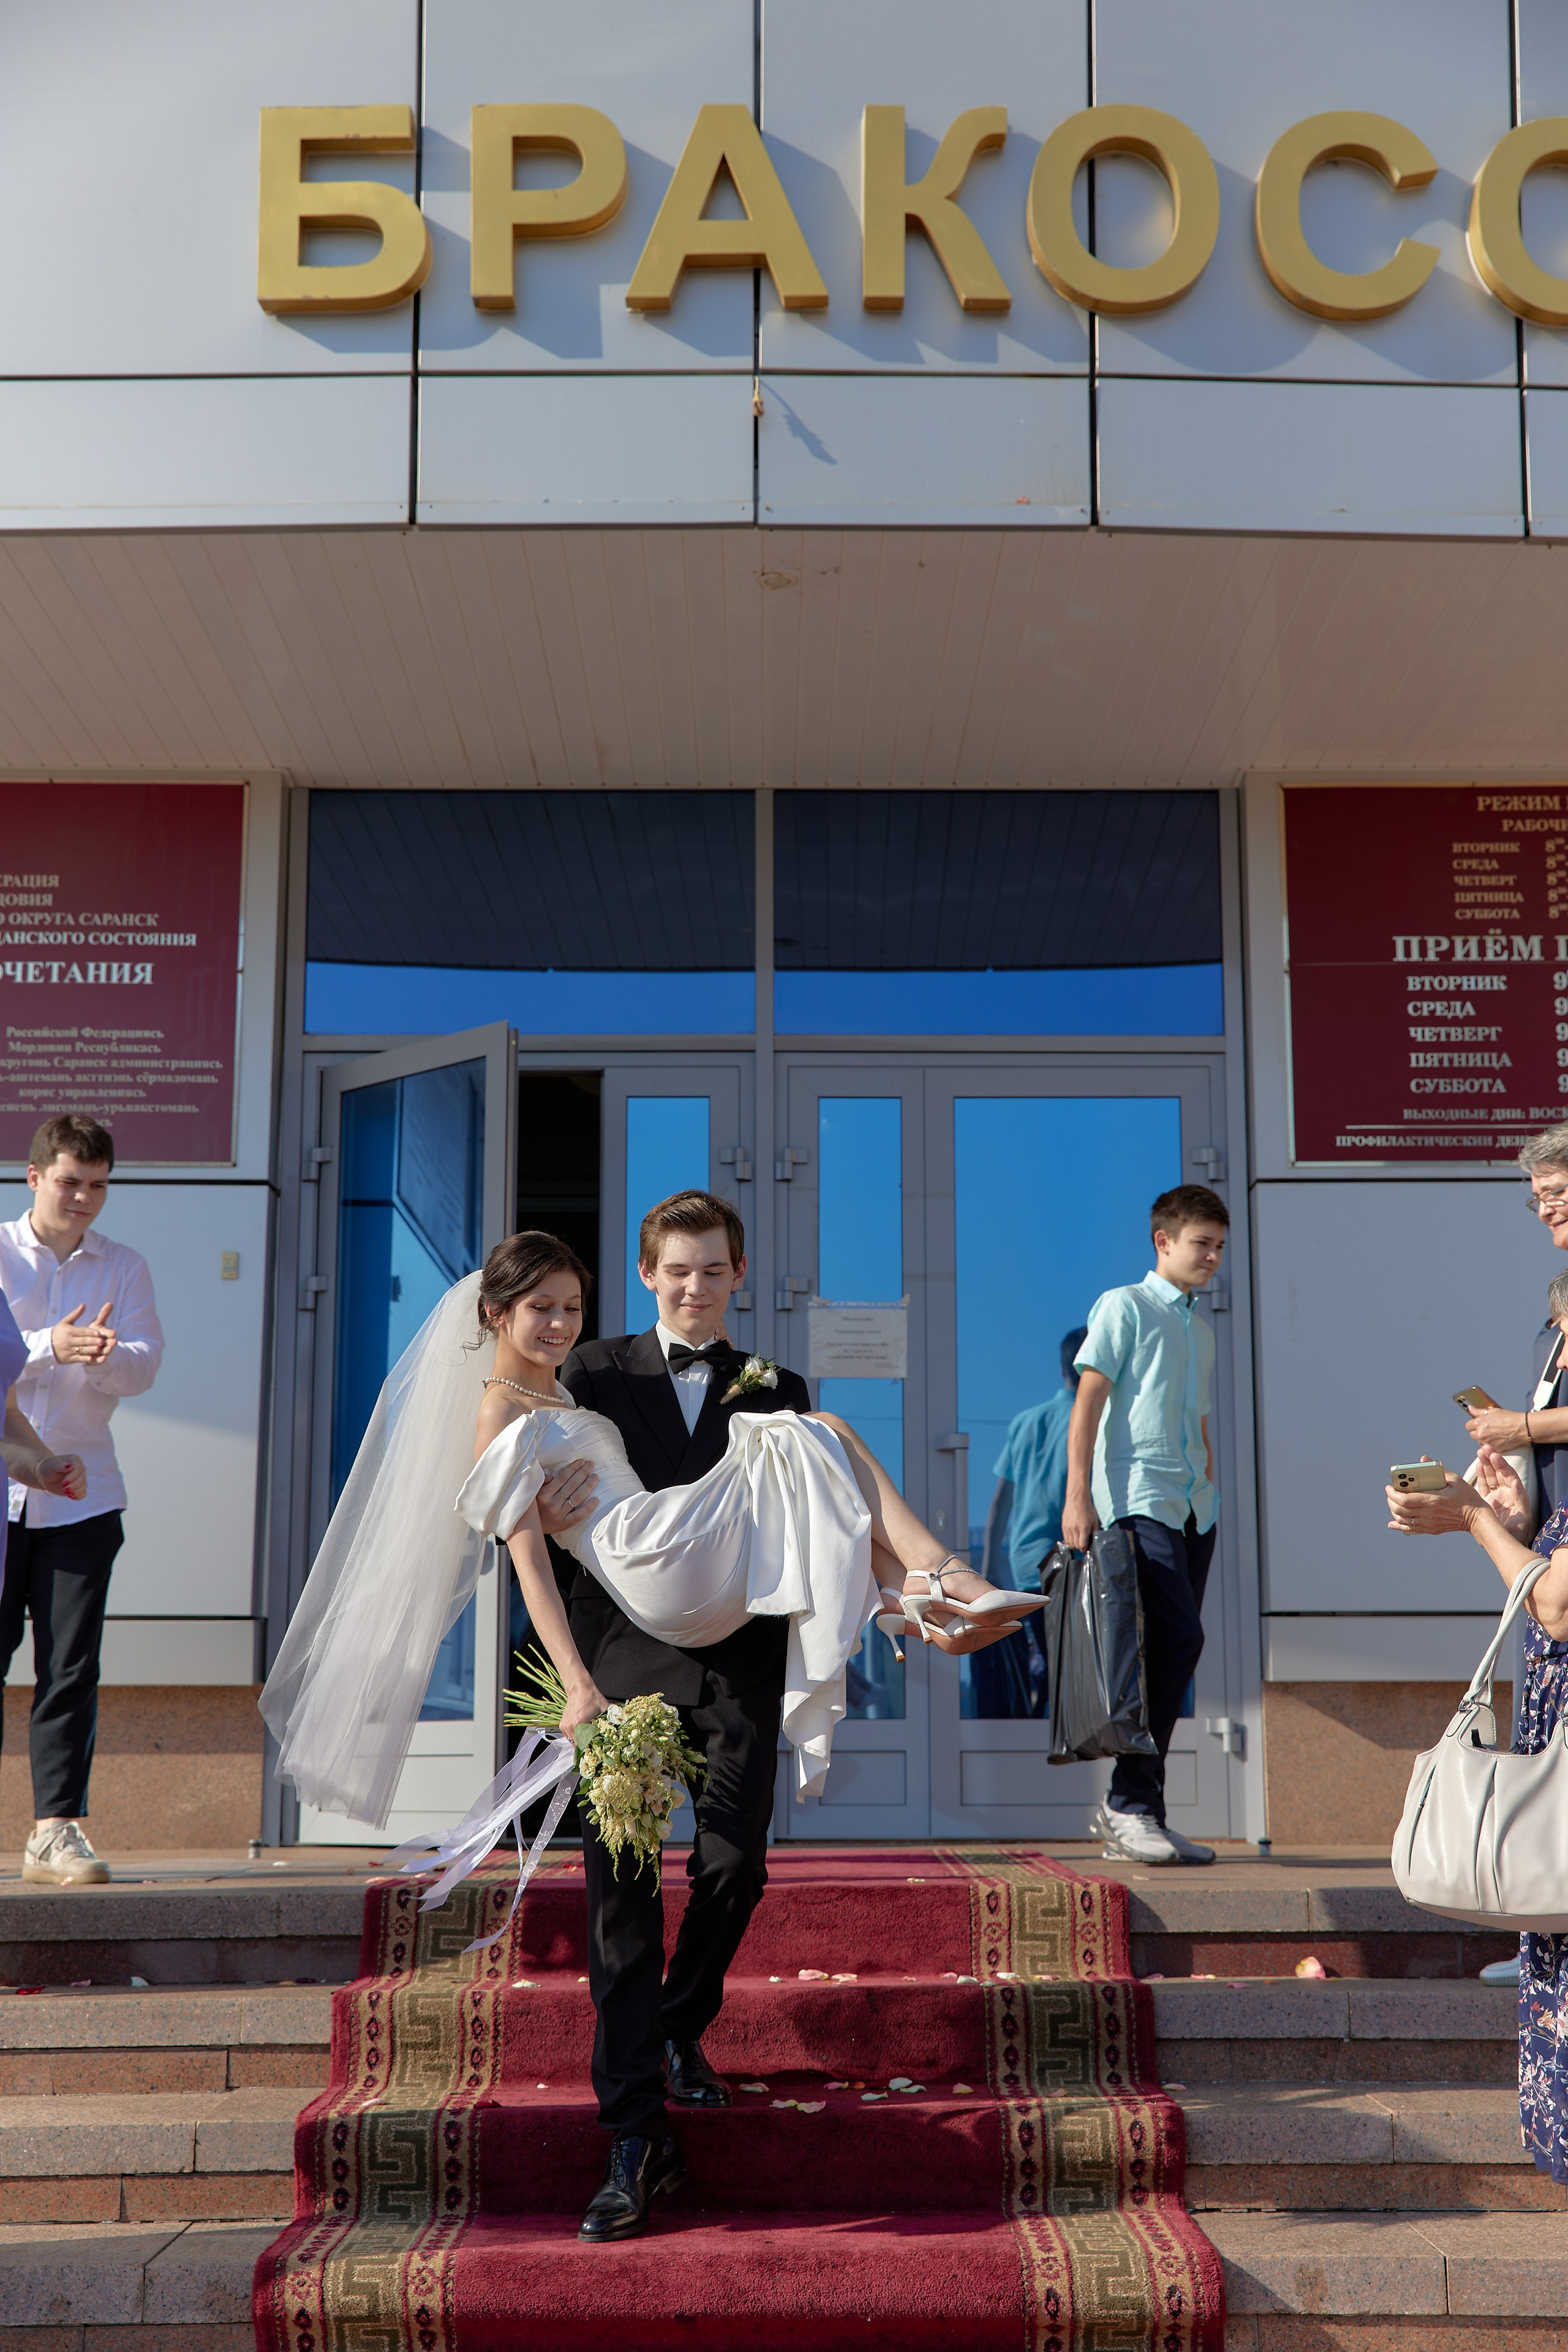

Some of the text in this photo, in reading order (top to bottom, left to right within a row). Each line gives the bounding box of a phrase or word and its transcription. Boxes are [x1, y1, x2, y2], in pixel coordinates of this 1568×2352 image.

[1477, 795, 1561, 812] РЕЖИМ
[1452, 842, 1520, 853] ВТОРНИК
[1452, 858, 1499, 871] СРЕДА
[0, 874, 59, 889] РАЦИЯ
[1453, 875, 1518, 886] ЧЕТВЕРГ
[1454, 891, 1525, 904] ПЯТНИЦА
[7, 911, 75, 925] ОКРУГА
[78, 912, 159, 927] САРАНСК
[1454, 908, 1521, 920] СУББОТА
[0, 931, 197, 946] АНСКОГО СОСТОЯНИЯ
[1392, 928, 1545, 962] ПРИЁМ
[0, 961, 154, 984] ЧЕТАНИЯ
[1407, 974, 1508, 991] ВТОРНИК
[1407, 1001, 1476, 1019] СРЕДА
[1408, 1026, 1502, 1042] ЧЕТВЕРГ
[53, 1056, 108, 1070] Саранск
[1409, 1052, 1512, 1070] ПЯТНИЦА
[1409, 1077, 1507, 1094] СУББОТА
[1403, 1108, 1489, 1121] ВЫХОДНЫЕ
